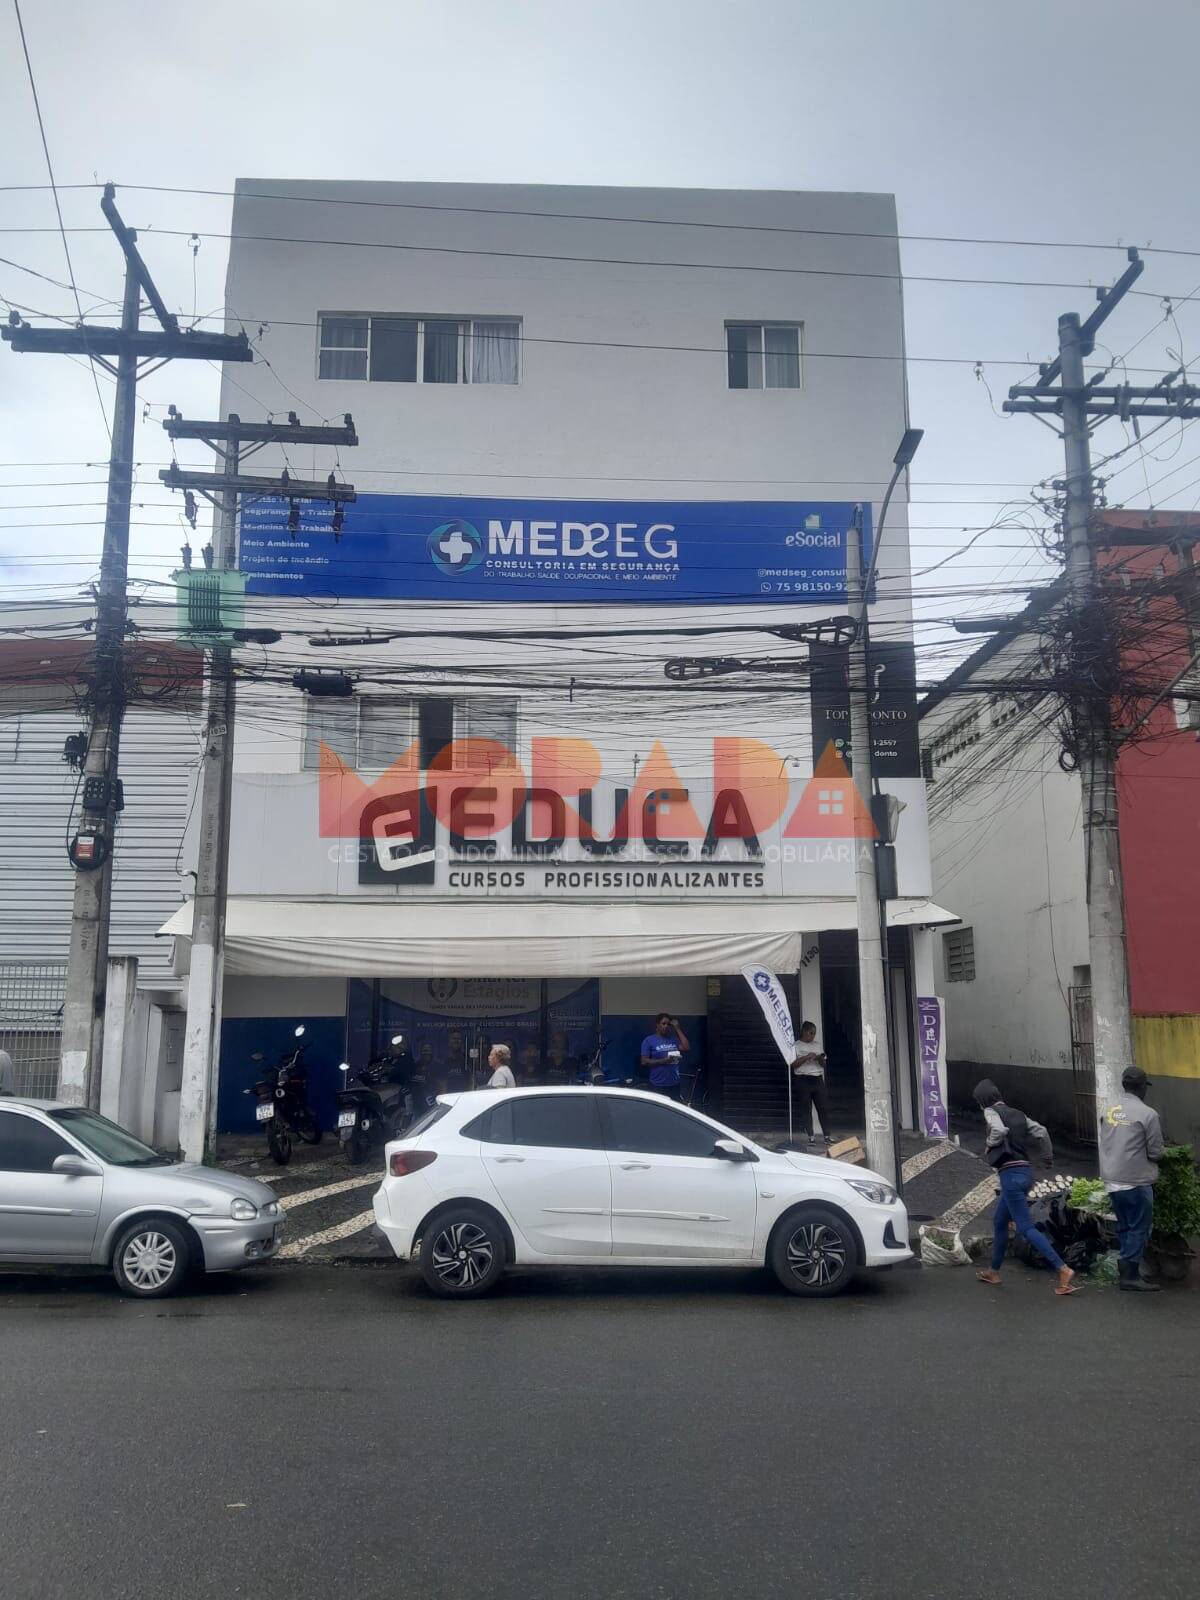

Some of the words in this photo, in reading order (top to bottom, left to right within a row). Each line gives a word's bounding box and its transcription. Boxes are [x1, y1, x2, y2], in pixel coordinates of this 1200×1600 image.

[267, 540, 310, 548] Ambiente
[488, 520, 678, 558] MEDSEG
[785, 531, 841, 547] eSocial
[242, 555, 275, 564] Projeto
[486, 560, 575, 570] CONSULTORIA
[580, 562, 597, 570] EM
[602, 562, 680, 572] SEGURANÇA
[643, 573, 677, 581] AMBIENTE
[776, 583, 790, 591] 75
[449, 786, 764, 856] EDUCA
[449, 872, 525, 888] CURSOS
[544, 872, 764, 888] PROFISSIONALIZANTES
[802, 946, 819, 967] 1130
[922, 1015, 943, 1132] DENTISTA
